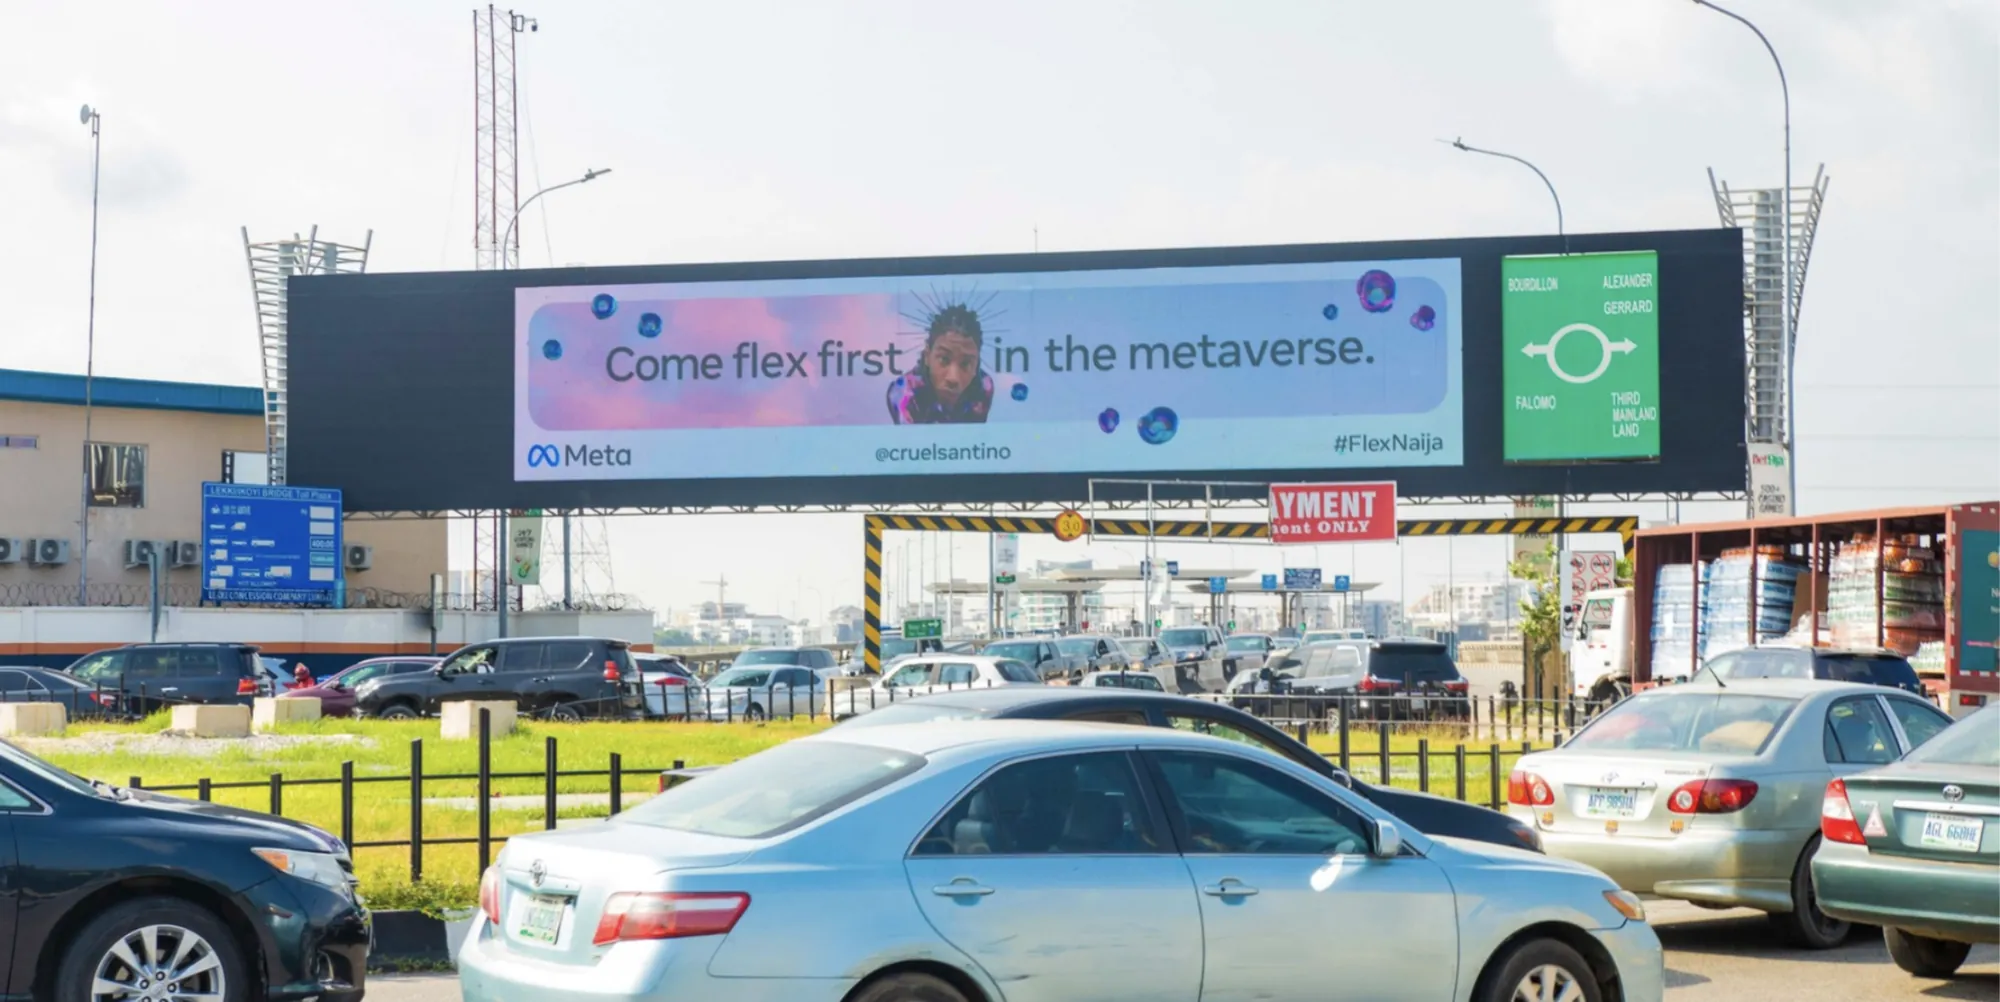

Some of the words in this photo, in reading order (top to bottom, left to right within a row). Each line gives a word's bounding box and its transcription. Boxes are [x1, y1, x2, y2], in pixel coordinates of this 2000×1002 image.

[1508, 277, 1558, 292] BOURDILLON
[1603, 273, 1653, 289] ALEXANDER
[1604, 300, 1653, 315] GERRARD
[606, 346, 723, 381] Come
[732, 341, 808, 379] flex
[817, 340, 904, 377] first
[993, 336, 1030, 373] in
[1044, 334, 1117, 372] the
[1129, 334, 1375, 370] metaverse.
[1516, 395, 1556, 410] FALOMO
[1611, 391, 1641, 406] THIRD
[1612, 407, 1656, 422] MAINLAND
[1612, 423, 1640, 437] LAND
[1334, 432, 1443, 456] #FlexNaija
[564, 443, 631, 467] Meta
[875, 442, 1012, 462] @cruelsantino
[1317, 520, 1370, 533] ONLY
